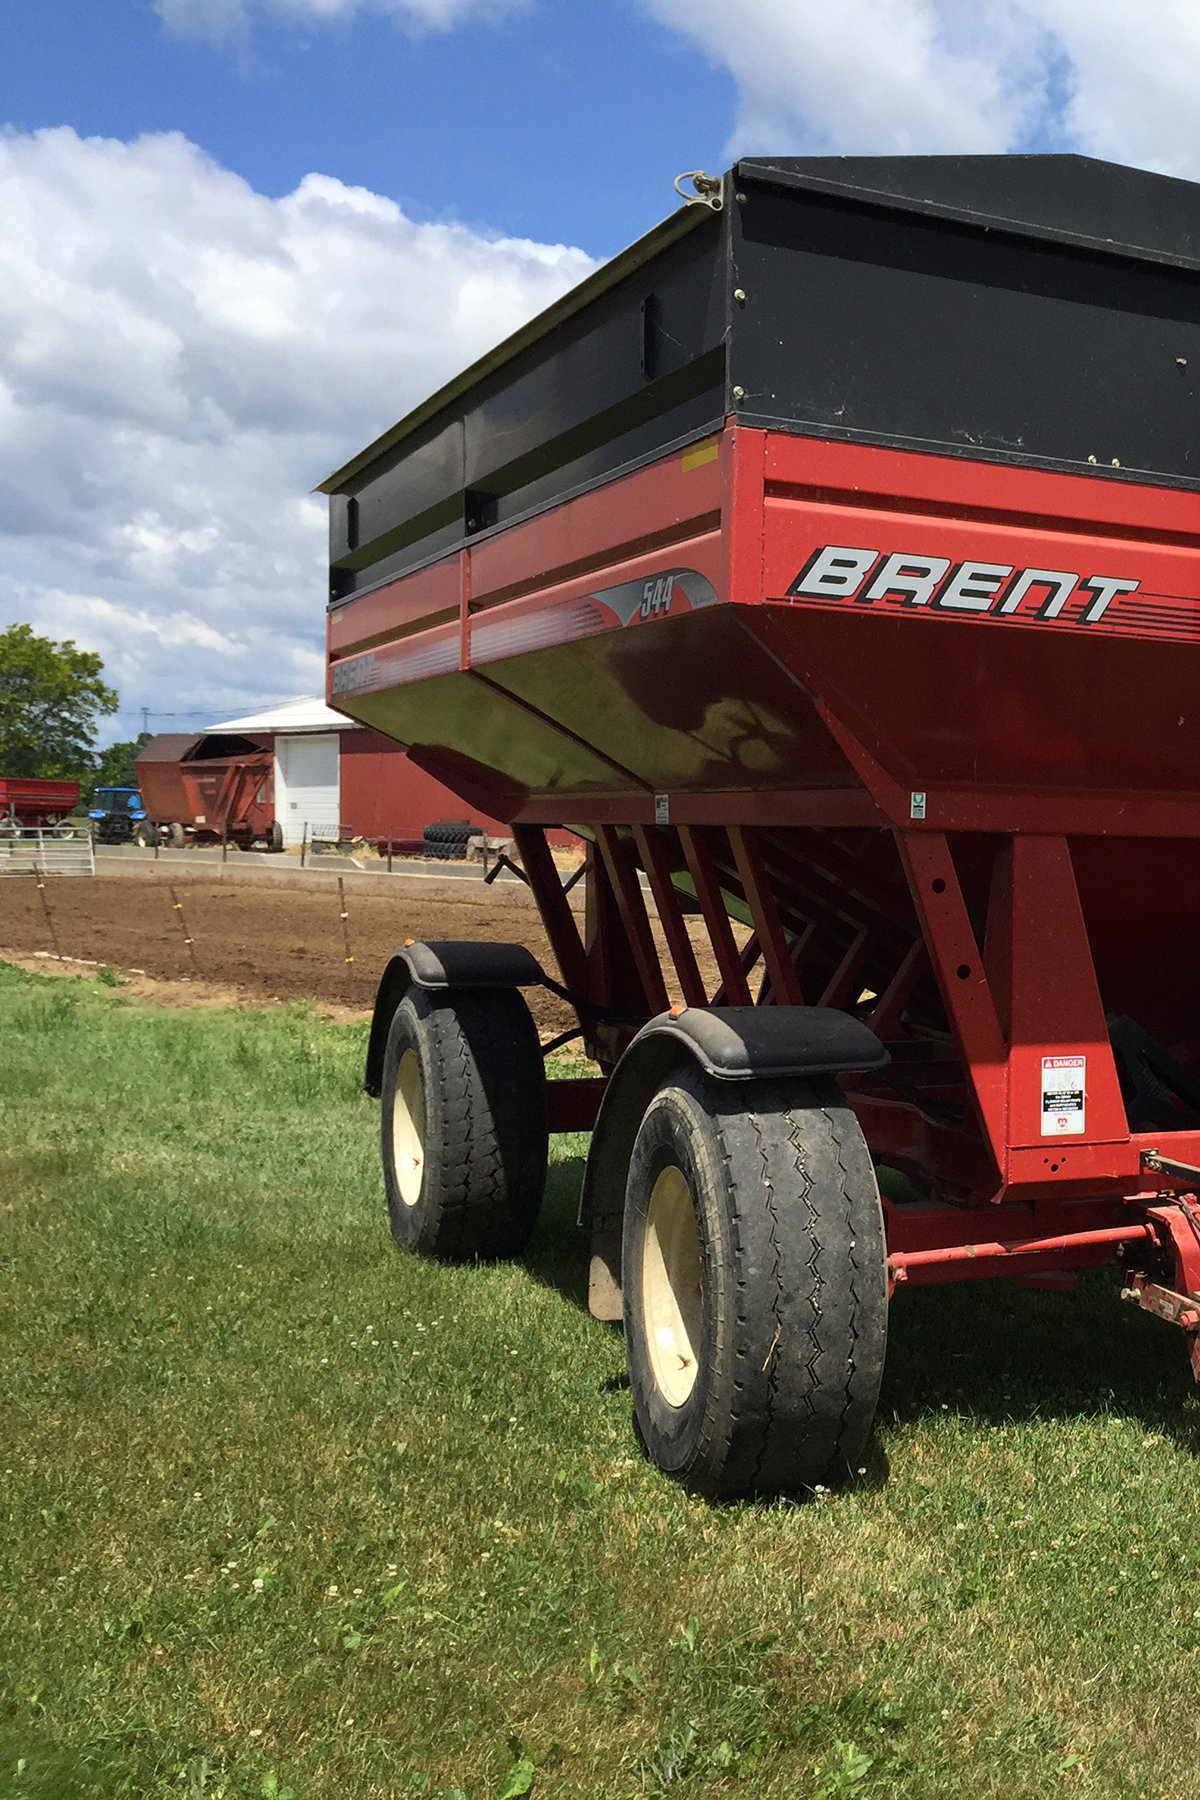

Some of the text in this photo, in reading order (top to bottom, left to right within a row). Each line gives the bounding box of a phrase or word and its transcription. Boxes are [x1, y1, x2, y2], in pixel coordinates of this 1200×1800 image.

[640, 575, 674, 618] 544
[788, 544, 1140, 623] BRENT
[1053, 1059, 1083, 1068] DANGER
